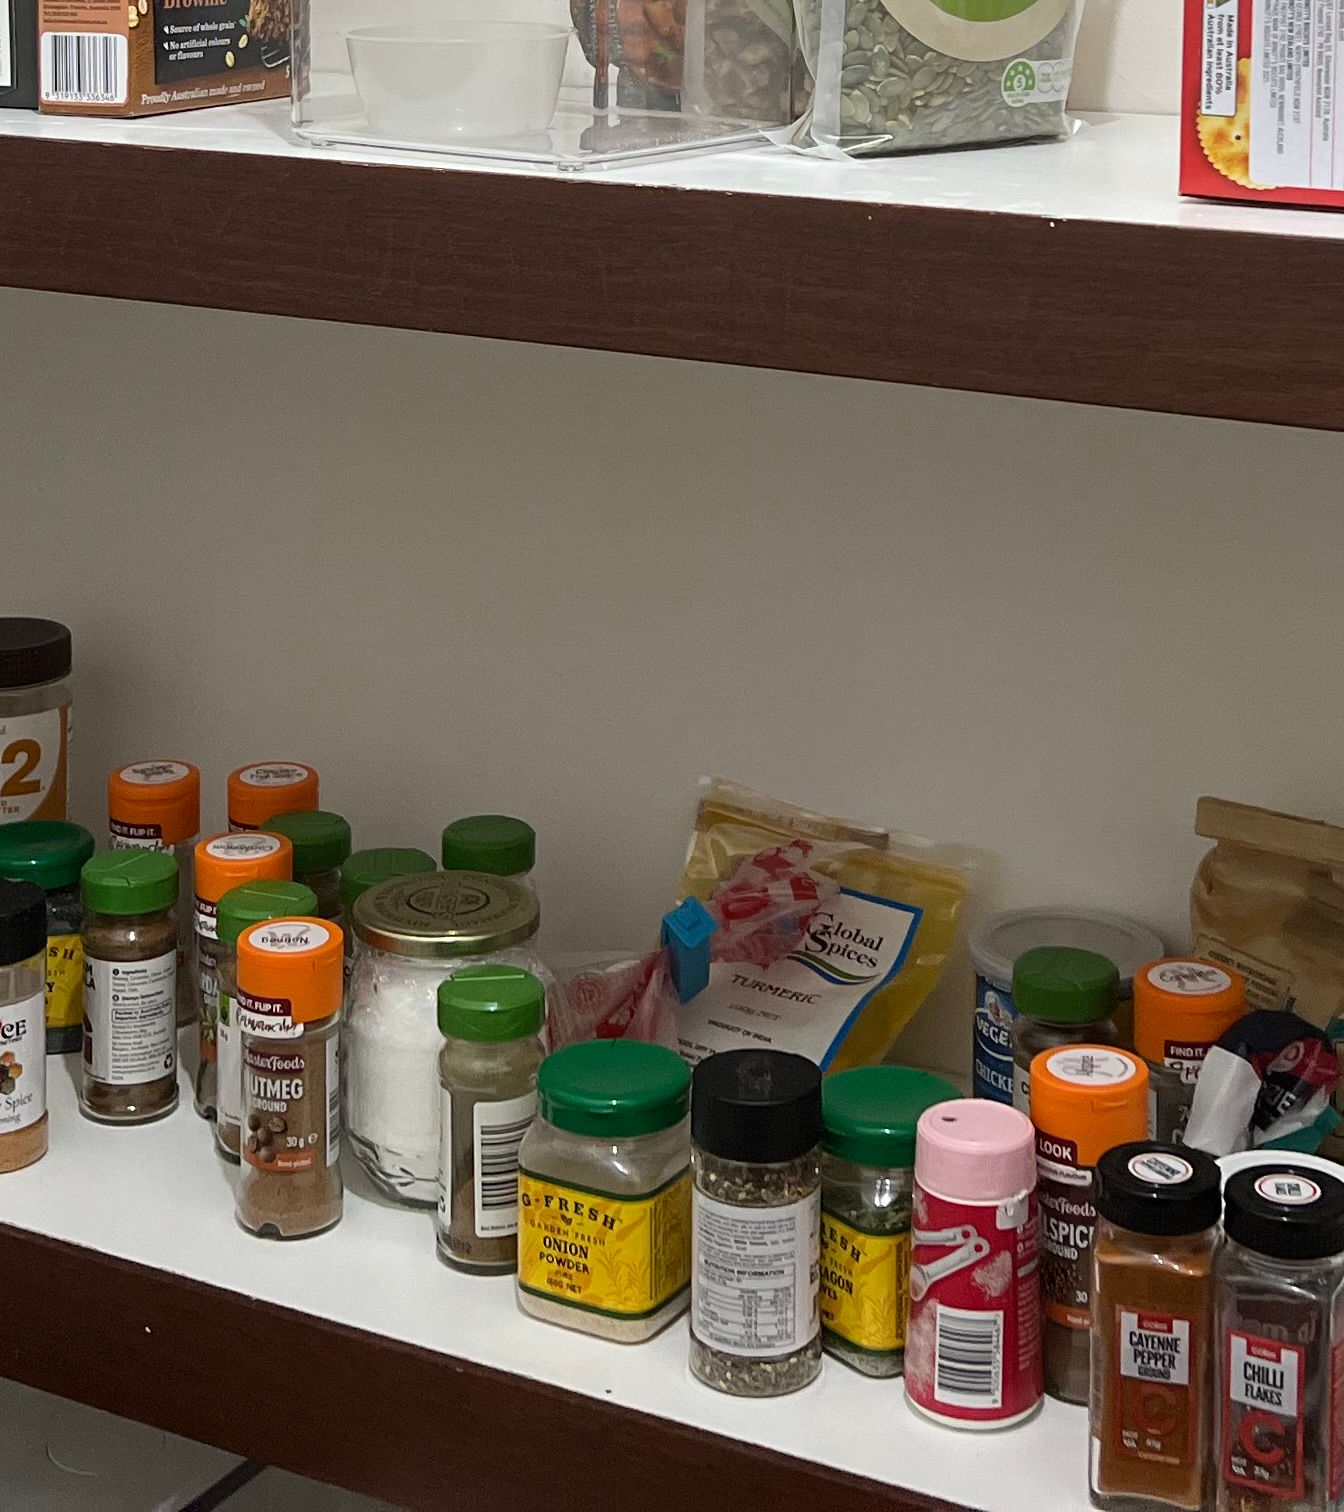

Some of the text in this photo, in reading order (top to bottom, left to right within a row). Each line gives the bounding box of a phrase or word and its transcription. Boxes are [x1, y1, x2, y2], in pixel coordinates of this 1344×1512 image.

[170, 22, 218, 34] Source of whole
[1215, 14, 1224, 35] from
[170, 37, 231, 50] No artificial colours
[1215, 37, 1224, 46] at
[1224, 14, 1234, 91] Made in Australia
[177, 50, 204, 60] flavours
[1203, 14, 1214, 110] Australian ingredients
[1214, 48, 1224, 70] least
[141, 80, 265, 106] Proudly Australian made and owned
[260, 935, 308, 945] Nutmeg
[807, 911, 884, 952] Global
[806, 929, 879, 969] Spices
[732, 974, 822, 1006] TURMERIC
[255, 1001, 272, 1012] FLIP
[707, 1019, 772, 1044] PRODUCT OF INDIA
[977, 1015, 1013, 1048] VEGE
[1170, 1045, 1191, 1056] FIND
[4, 1092, 33, 1112] Spice
[286, 1137, 297, 1148] 30
[1040, 1138, 1073, 1161] LOOK
[530, 1220, 605, 1246] GARDEN FRESH
[543, 1235, 589, 1259] ONION
[539, 1252, 589, 1274] POWDER
[566, 1283, 582, 1294] NET
[1076, 1290, 1088, 1304] 30
[1129, 1331, 1180, 1353] CAYENNE
[1133, 1349, 1176, 1369] PEPPER
[1243, 1361, 1284, 1390] CHILLI
[1244, 1383, 1282, 1407] FLAKES
